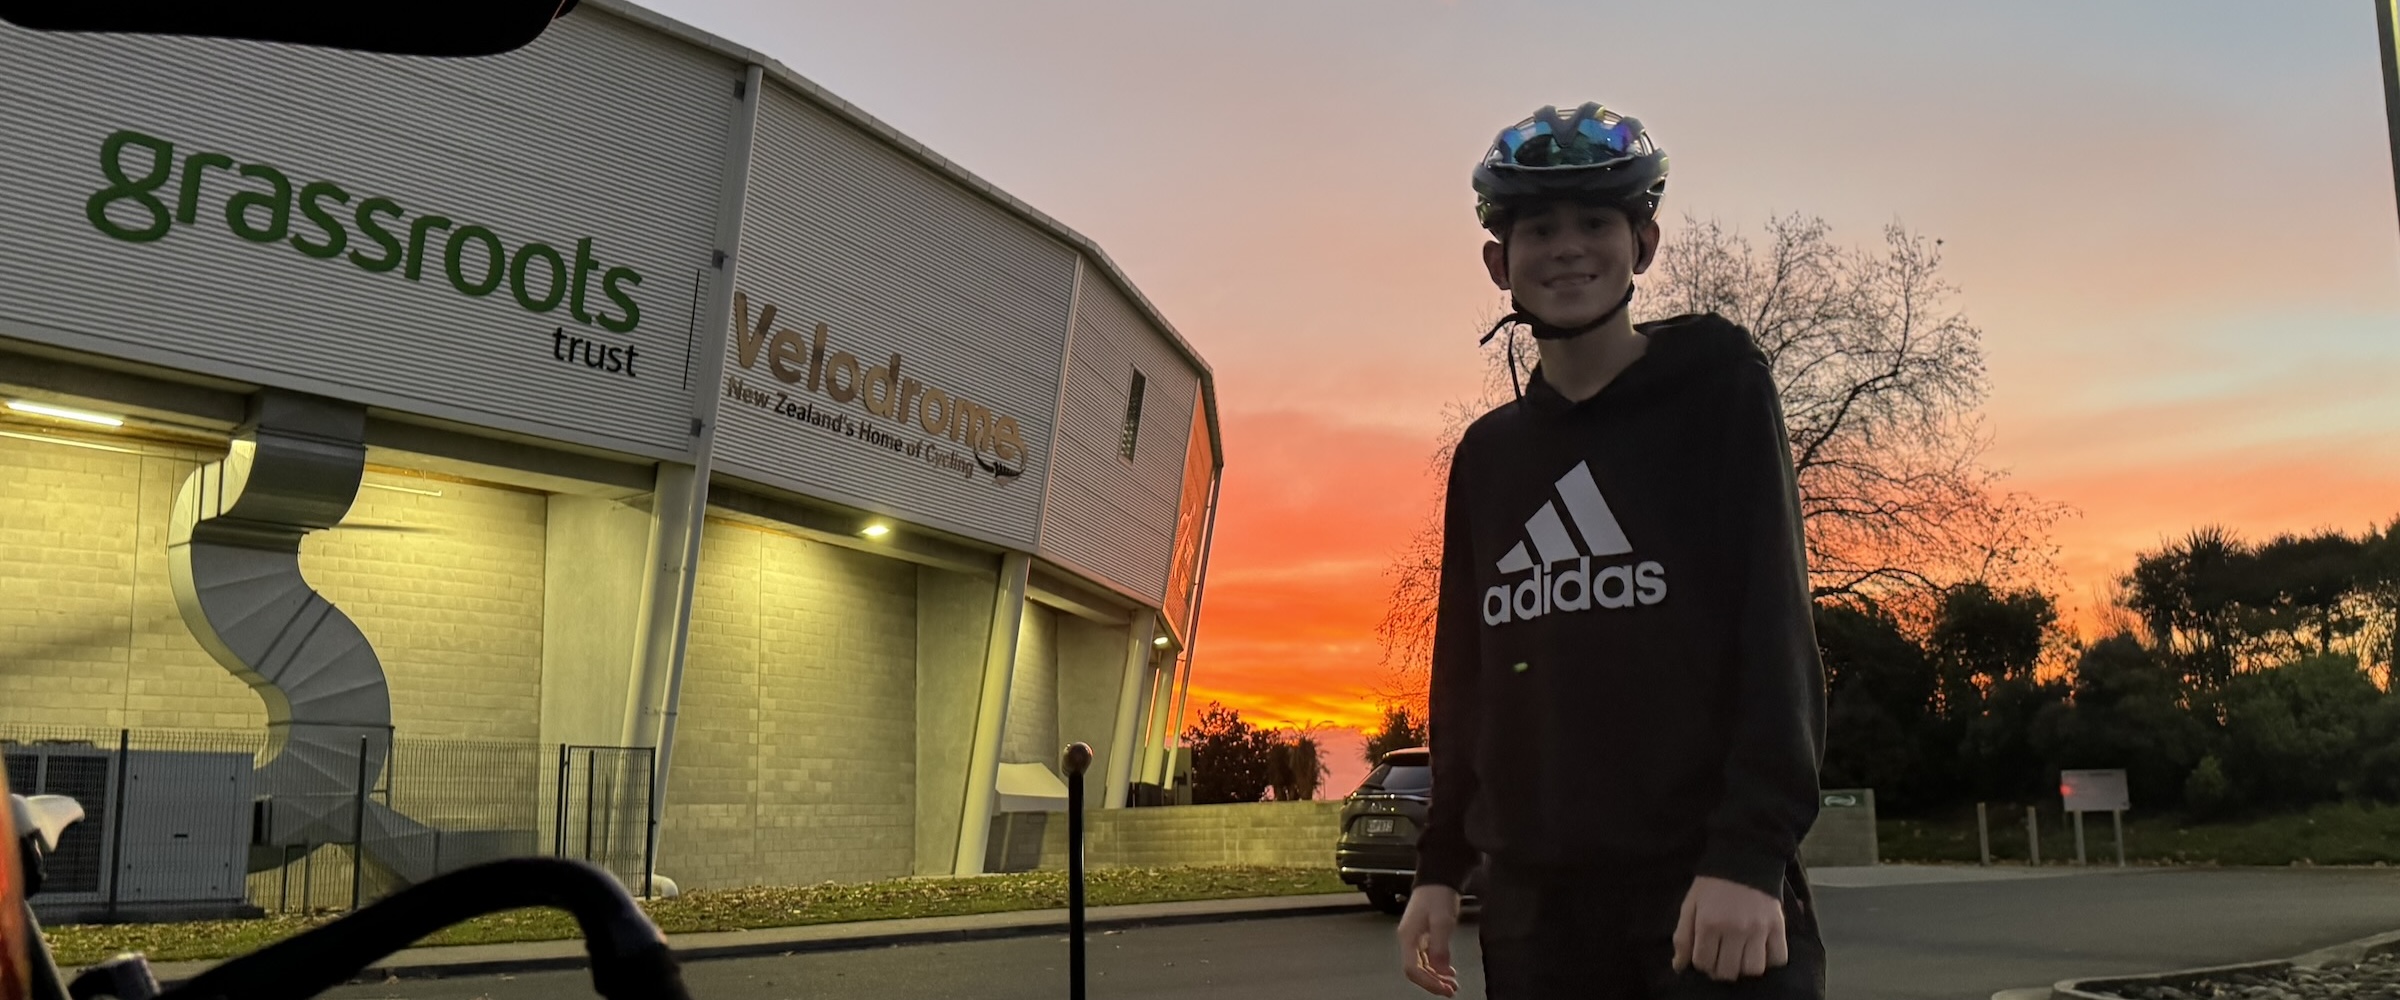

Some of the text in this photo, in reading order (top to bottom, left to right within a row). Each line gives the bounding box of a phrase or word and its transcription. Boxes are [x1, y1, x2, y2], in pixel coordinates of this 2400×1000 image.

[86, 129, 642, 333] grassroots
[552, 327, 639, 377] trust
[734, 290, 1022, 460] Velodrome
[727, 376, 974, 479] New Zealand's Home of Cycling
[1483, 556, 1667, 626] adidas
